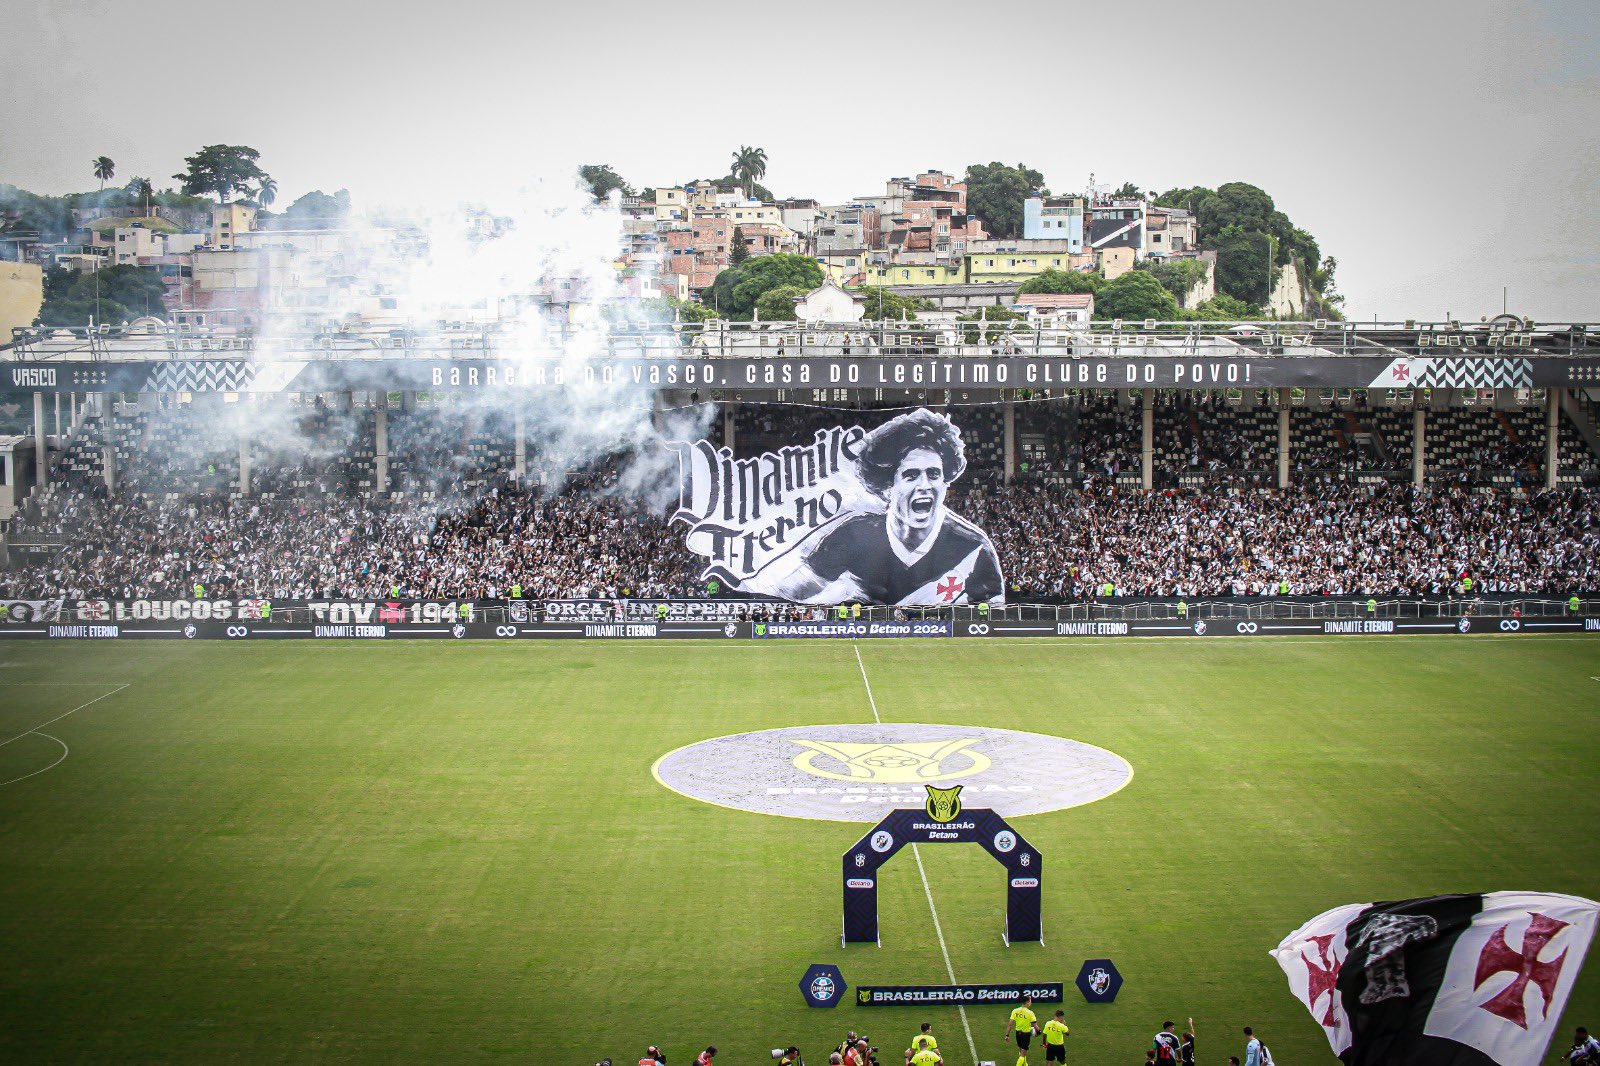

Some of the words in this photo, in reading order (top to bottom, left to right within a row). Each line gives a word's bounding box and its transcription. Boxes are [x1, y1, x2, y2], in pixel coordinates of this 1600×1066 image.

[12, 368, 57, 387] VASCO
[584, 365, 614, 384] DO
[829, 363, 860, 384] DO
[1126, 363, 1156, 383] DO
[1174, 363, 1251, 383] POVO!
[666, 426, 865, 527] Dinamite
[688, 488, 843, 588] Eterno
[115, 600, 233, 620] LOUCOS
[49, 625, 88, 637] DINAMITE
[89, 625, 119, 637] ETERNO
[315, 625, 354, 637] DINAMITE
[355, 625, 386, 637] ETERNO
[585, 624, 625, 637] DINAMITE
[626, 624, 657, 637] ETERNO
[769, 623, 867, 635] BRASILEIRÃO
[869, 624, 911, 635] Betano
[913, 624, 948, 634] 2024
[1057, 622, 1097, 635] DINAMITE
[1097, 622, 1128, 635] ETERNO
[1324, 621, 1363, 632] DINAMITE
[1363, 620, 1394, 632] ETERNO
[912, 821, 976, 830] BRASILEIRÃO
[928, 831, 959, 839] Betano
[873, 989, 975, 1001] BRASILEIRÃO
[977, 989, 1020, 1000] Betano
[1022, 989, 1058, 998] 2024
[1015, 1012, 1028, 1020] TCL
